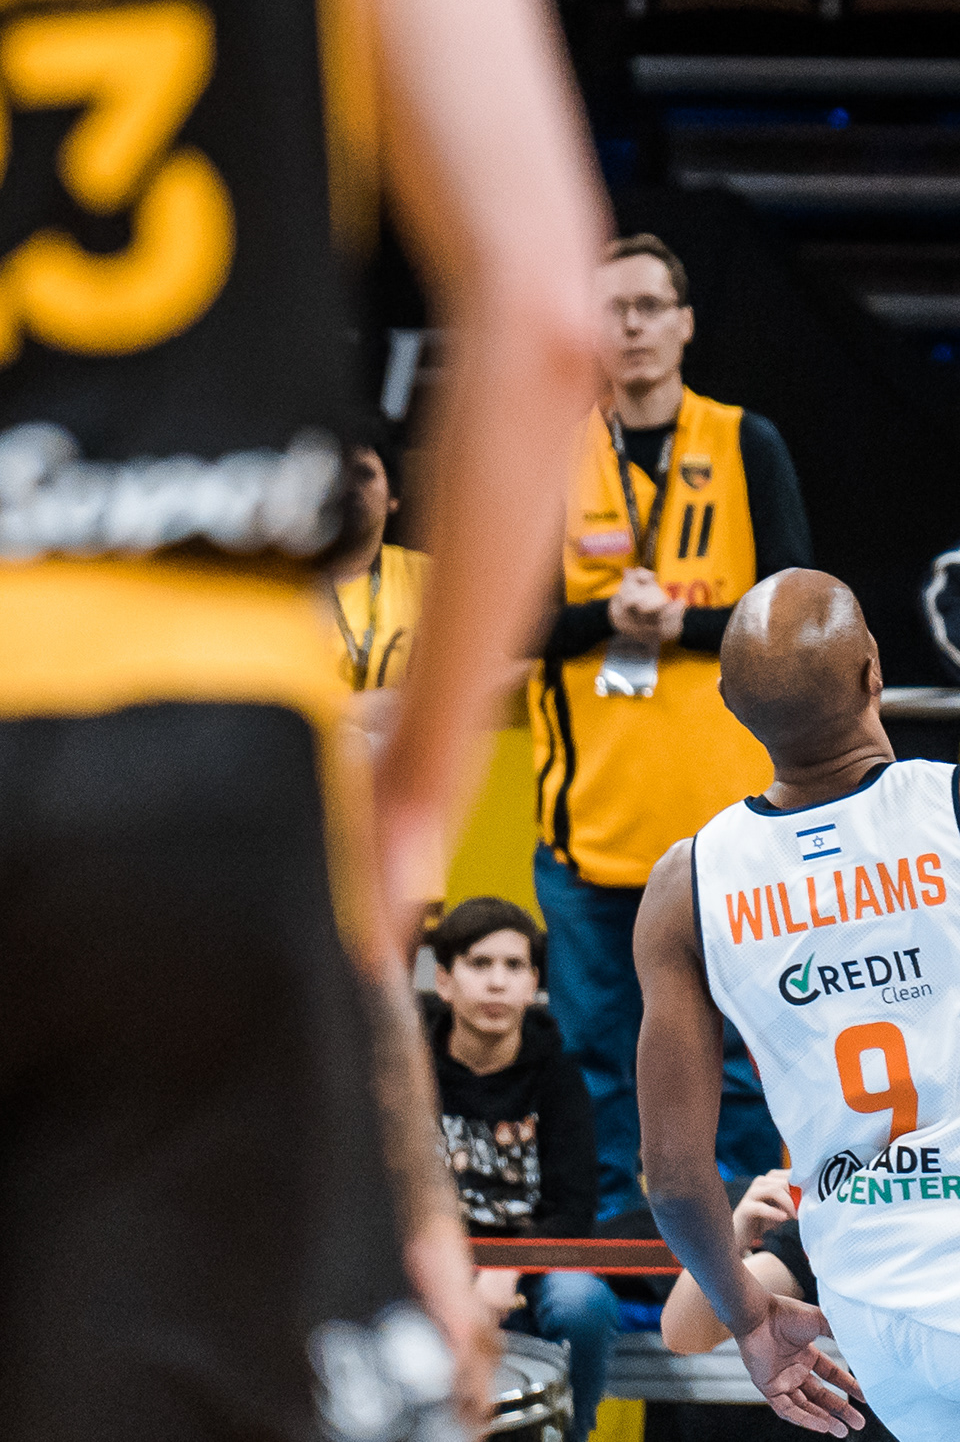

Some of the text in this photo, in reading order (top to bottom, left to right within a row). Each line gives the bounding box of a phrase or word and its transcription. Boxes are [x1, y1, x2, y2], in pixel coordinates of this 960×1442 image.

[726, 852, 948, 945] WILLIAMS
[778, 947, 925, 1006] CREDIT
[881, 982, 933, 1005] Clean
[834, 1021, 919, 1145] 9
[866, 1145, 942, 1174] ADE
